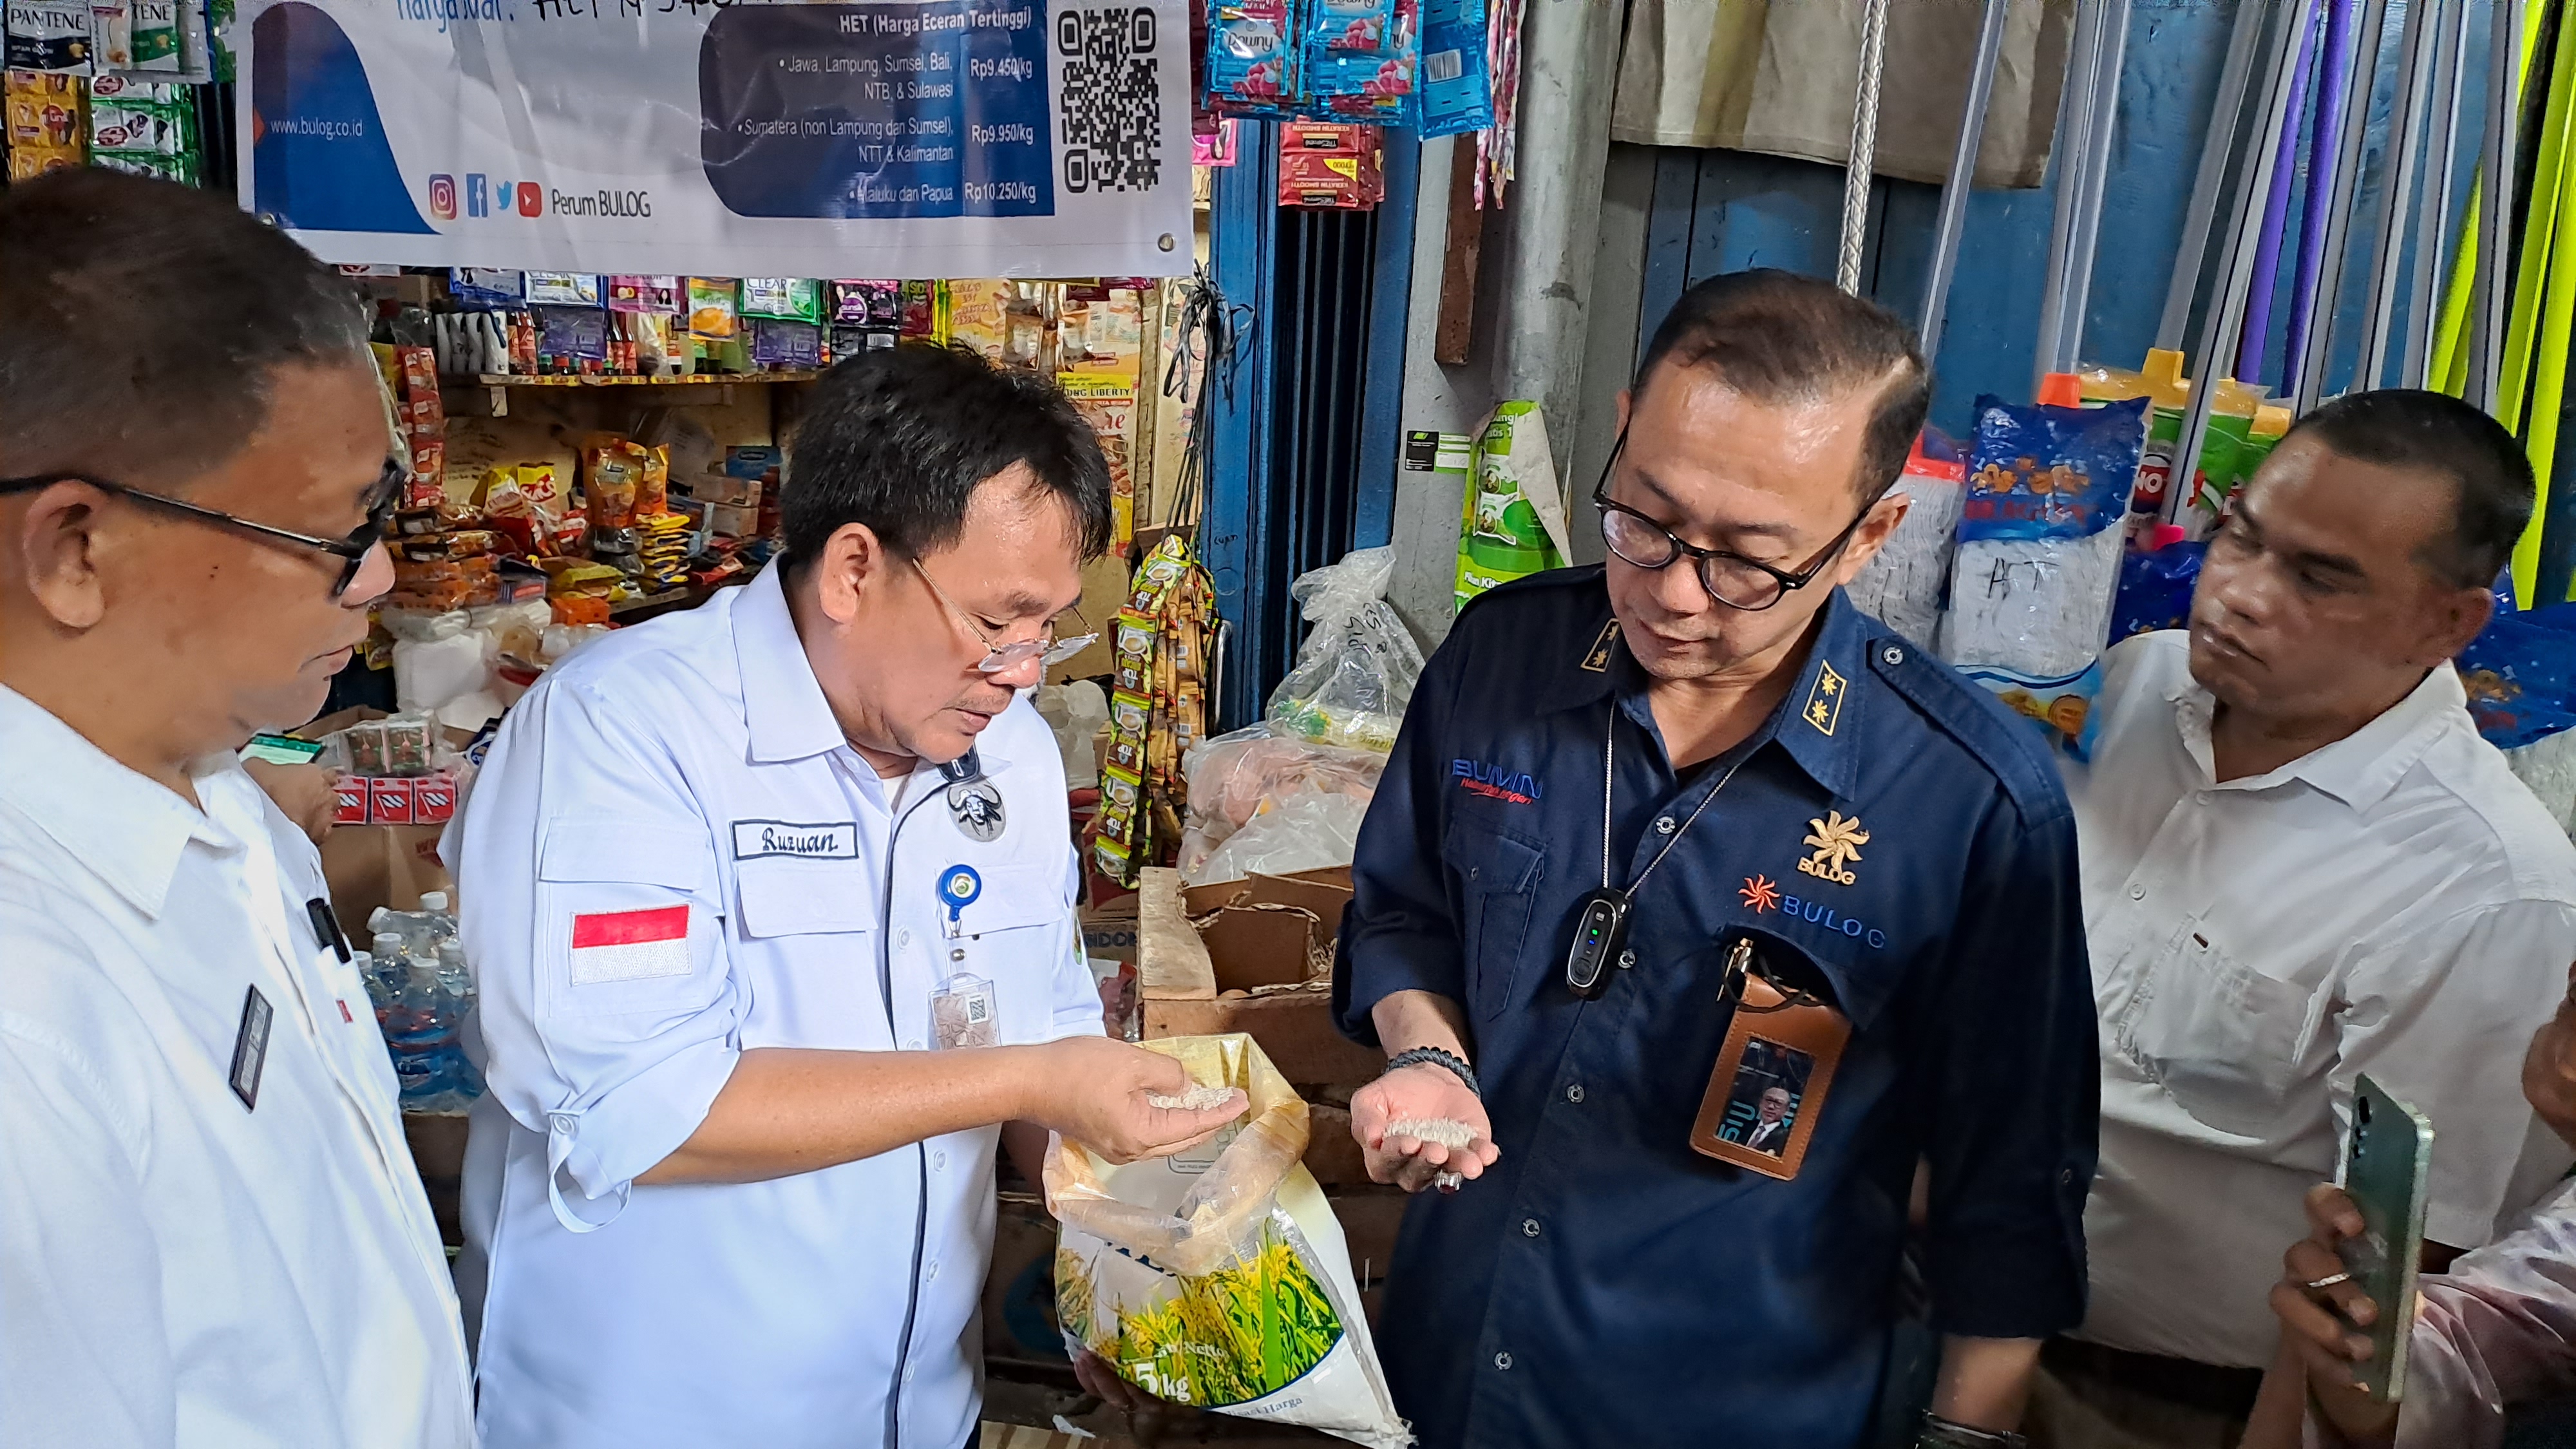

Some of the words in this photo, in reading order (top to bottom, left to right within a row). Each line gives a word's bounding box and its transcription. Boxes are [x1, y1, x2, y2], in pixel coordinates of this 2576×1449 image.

[11, 8, 85, 31] PANTENE
[839, 15, 868, 33] HET
[873, 14, 919, 37] (Harga
[923, 12, 964, 32] Eceran
[969, 6, 1032, 30] Tertinggi)
[1229, 32, 1273, 53] Downy
[788, 55, 821, 73] Jawa,
[825, 56, 881, 77] Lampung,
[885, 53, 927, 73] Sumsel,
[930, 52, 952, 71] Bali,
[970, 58, 1032, 80] Rp9.450/kg
[896, 82, 904, 100] &
[907, 80, 953, 99] Sulawesi
[270, 116, 363, 140] www.bulog.co.id
[744, 118, 797, 136] Sumatera
[801, 118, 826, 138] (non
[829, 118, 882, 140] Lampung
[886, 118, 905, 135] dan
[908, 116, 954, 137] Sumsel),
[972, 124, 1033, 146] Rp9.950/kg
[858, 145, 883, 162] NTT
[887, 147, 894, 163] &
[896, 145, 954, 162] Kalimantan
[553, 189, 596, 216] Perum
[600, 190, 651, 218] BULOG
[857, 185, 896, 202] Maluku
[898, 185, 919, 202] dan
[922, 184, 954, 204] Papua
[965, 182, 1036, 204] Rp10.250/kg
[747, 278, 787, 290] CLEAR
[1090, 388, 1130, 397] LIBERTY
[1136, 591, 1151, 602] TOP
[1122, 668, 1139, 680] TOP
[1117, 743, 1133, 757] TOP
[1452, 759, 1544, 799] BUMN
[1106, 817, 1122, 831] TOP
[762, 827, 838, 852] Ruzuan
[1797, 856, 1856, 886] BULOG
[1782, 895, 1886, 949] BULOG
[1135, 1363, 1158, 1394] 5
[1162, 1373, 1191, 1403] kg
[1263, 1396, 1303, 1415] Harga
